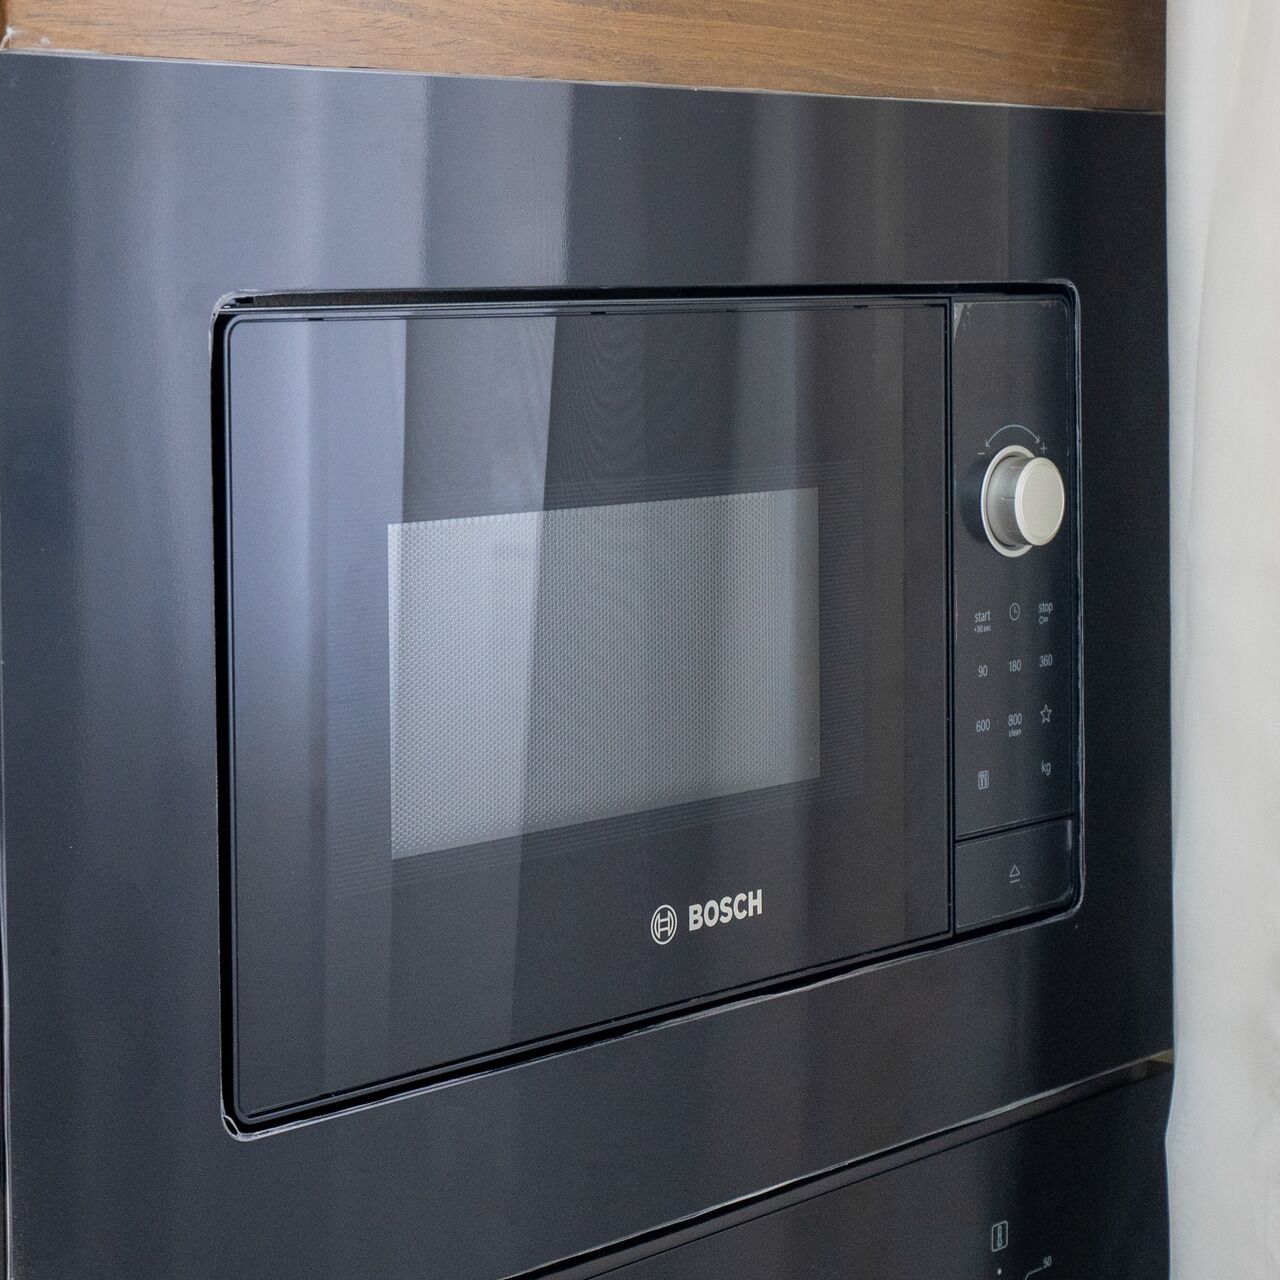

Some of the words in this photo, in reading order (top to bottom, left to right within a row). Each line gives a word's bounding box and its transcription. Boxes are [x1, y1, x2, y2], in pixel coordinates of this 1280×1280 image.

[974, 610, 991, 622] start
[1038, 602, 1053, 615] stop
[978, 665, 988, 678] 90
[1008, 659, 1022, 672] 180
[1039, 654, 1053, 667] 360
[976, 719, 990, 732] 600
[1008, 713, 1022, 726] 800
[1008, 728, 1022, 736] clean
[1041, 760, 1051, 776] kg
[688, 888, 763, 931] BOSCH
